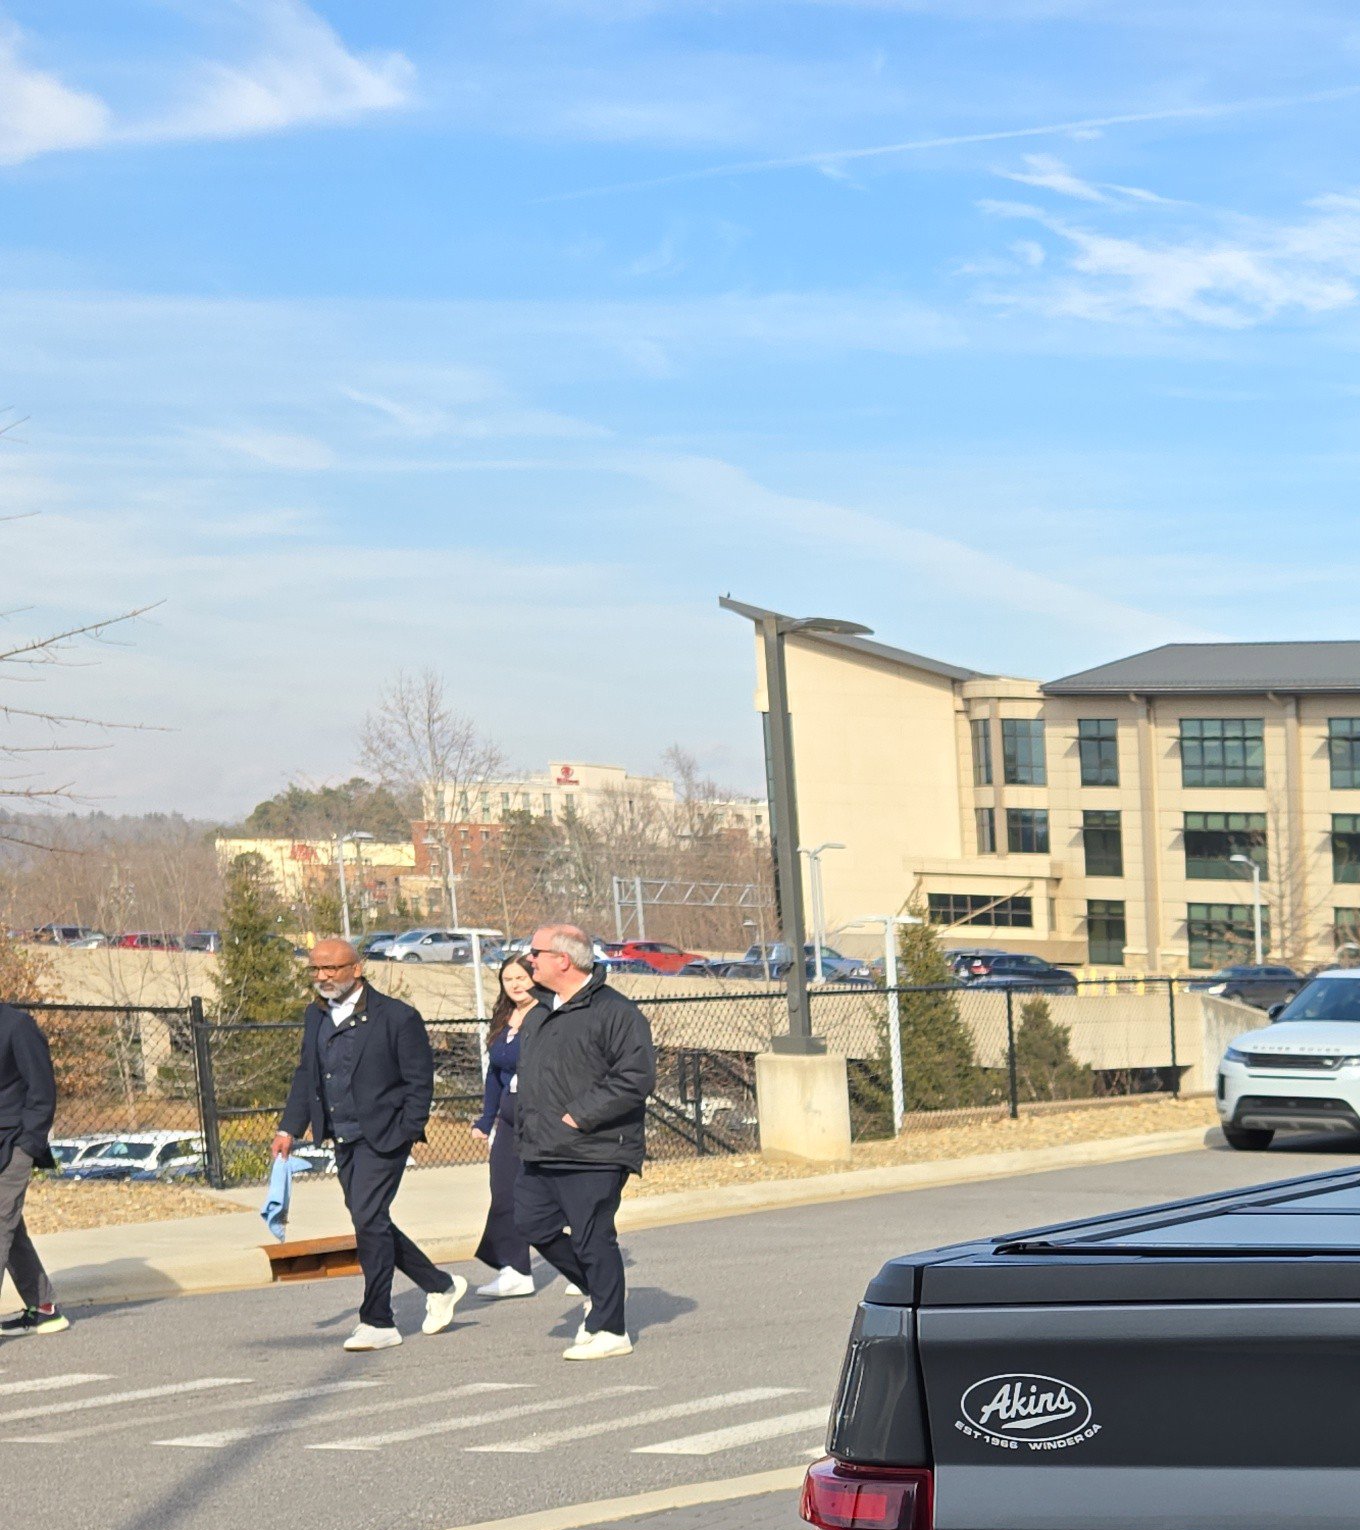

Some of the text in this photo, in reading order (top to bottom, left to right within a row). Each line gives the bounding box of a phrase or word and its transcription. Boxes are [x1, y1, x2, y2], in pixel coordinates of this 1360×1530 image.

[979, 1381, 1077, 1429] Akins
[954, 1420, 982, 1439] EST
[1028, 1435, 1085, 1451] WINDER
[1083, 1423, 1103, 1439] GA
